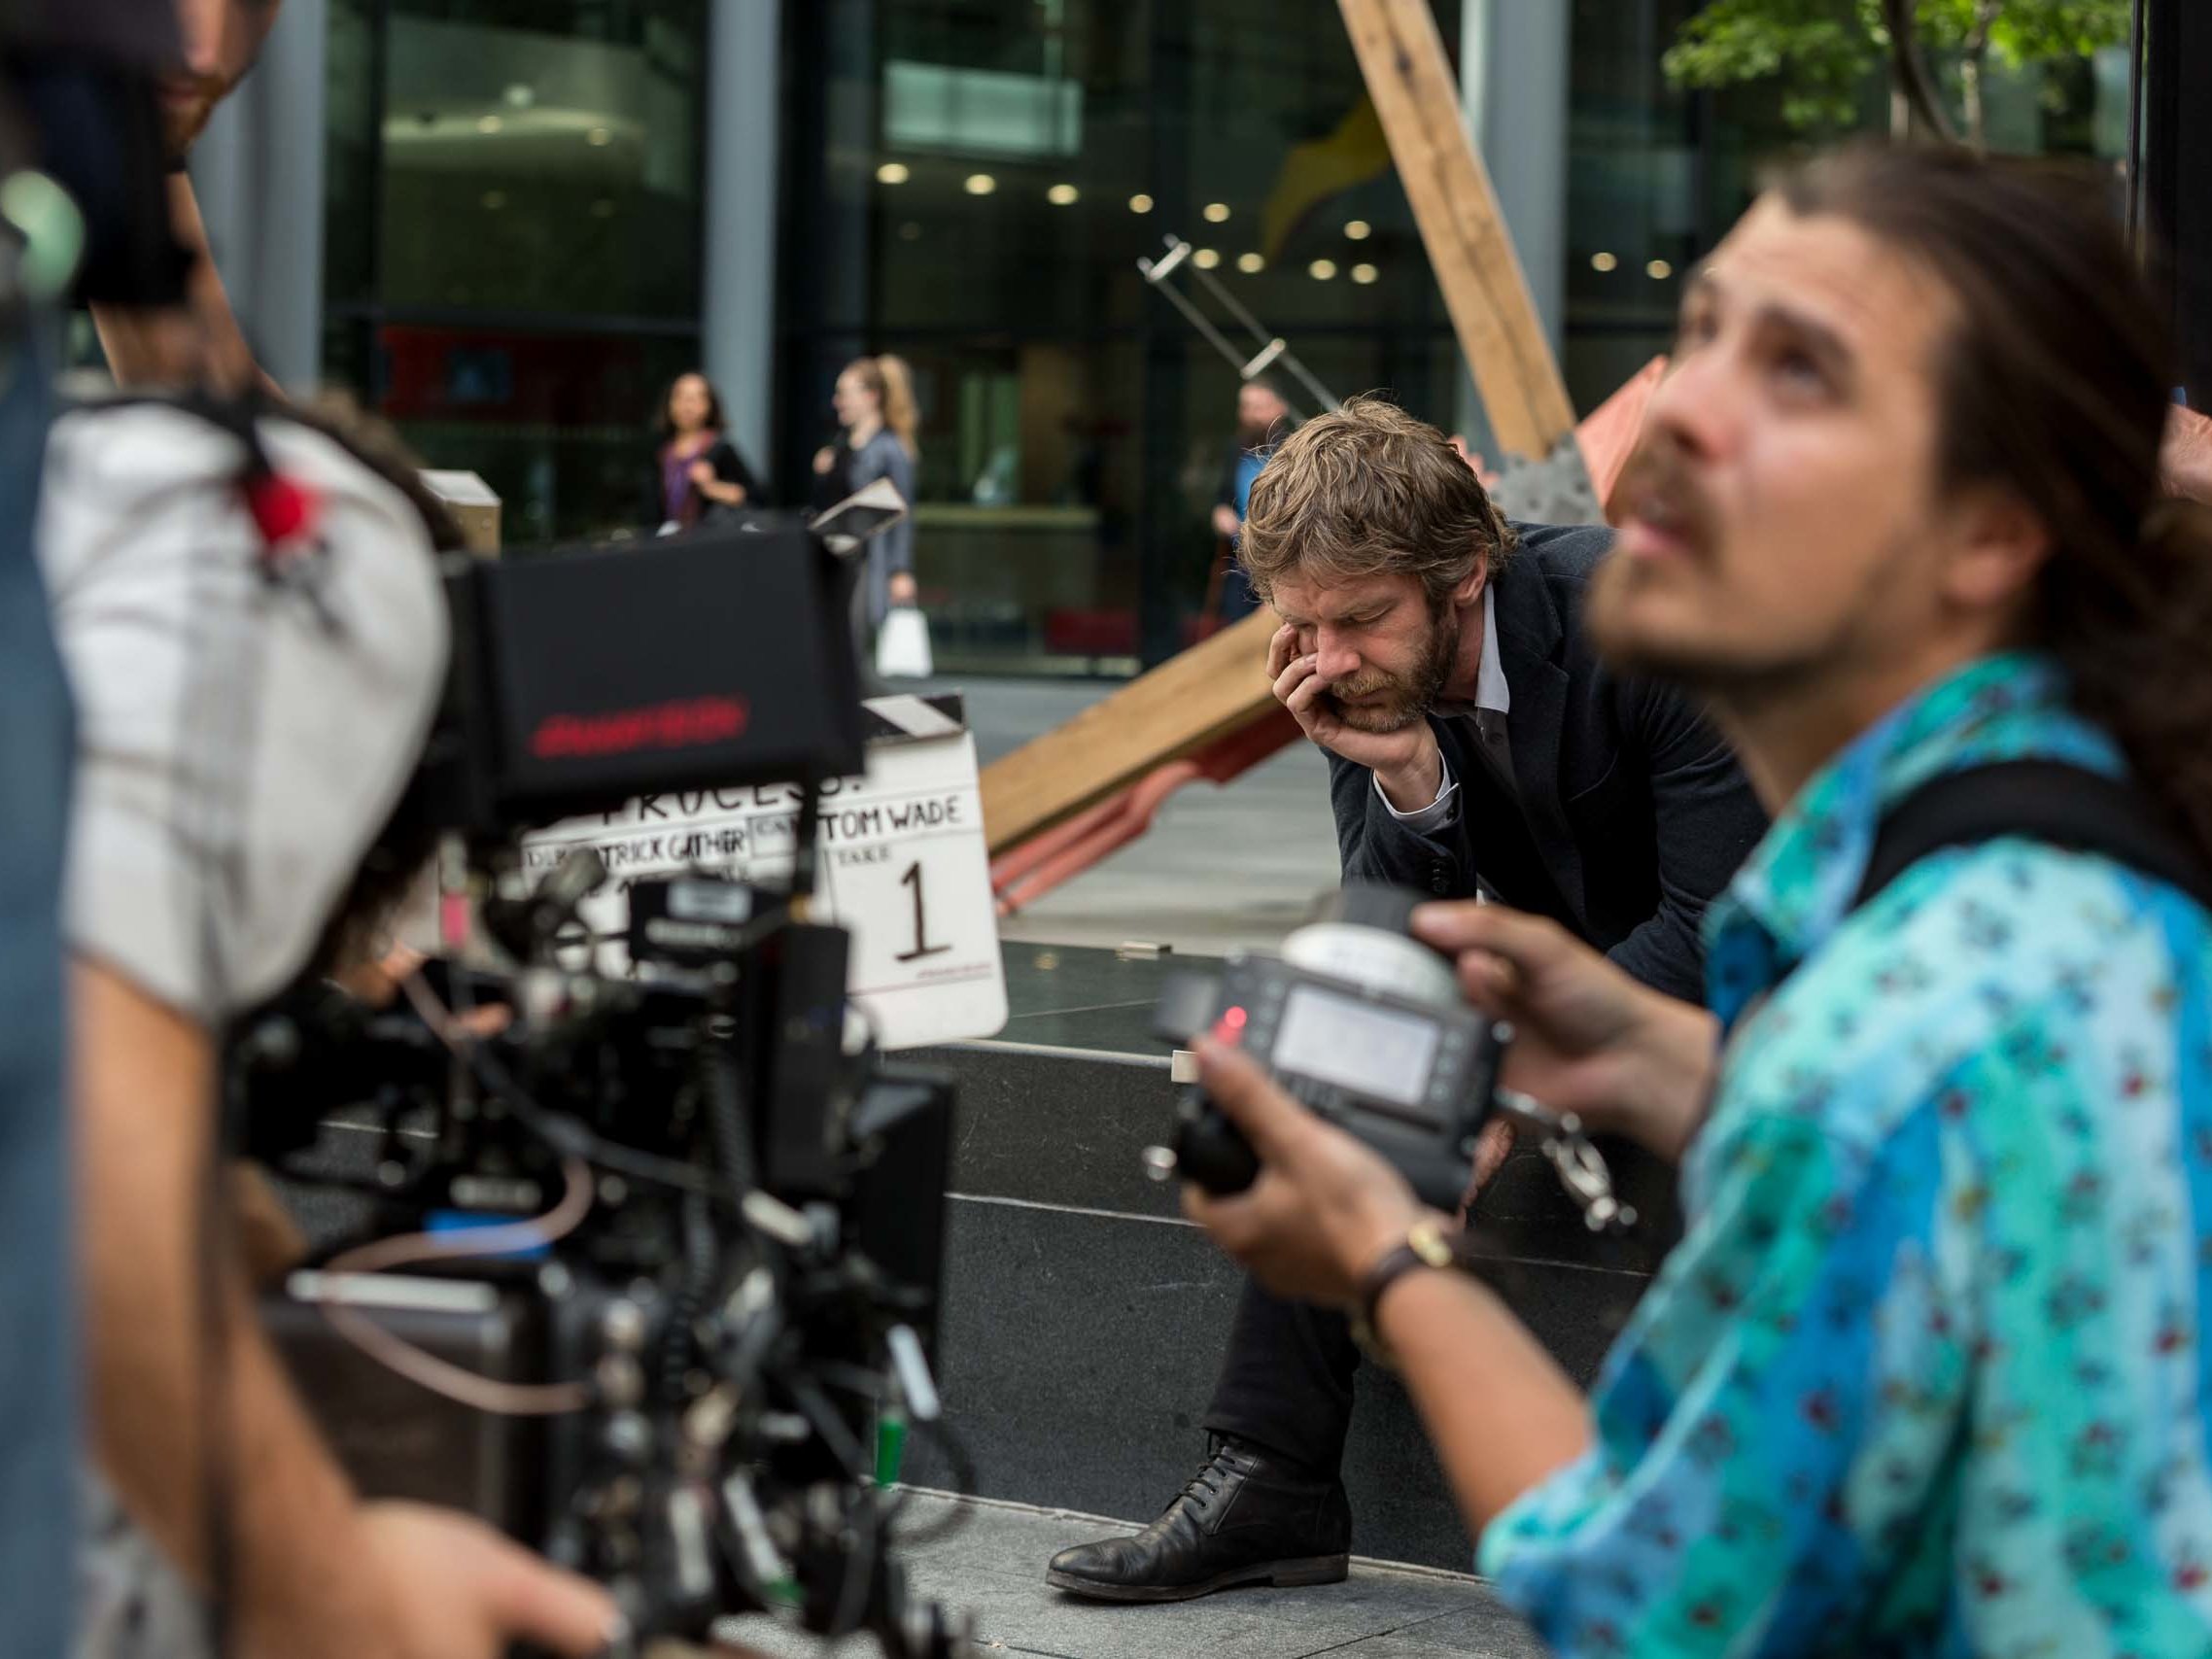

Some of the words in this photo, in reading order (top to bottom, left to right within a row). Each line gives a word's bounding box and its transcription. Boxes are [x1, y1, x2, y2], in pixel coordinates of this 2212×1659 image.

[817, 809, 884, 841] TOM
[886, 795, 963, 830] WADE
[837, 843, 888, 866] TAKE
[894, 859, 953, 964] 1
